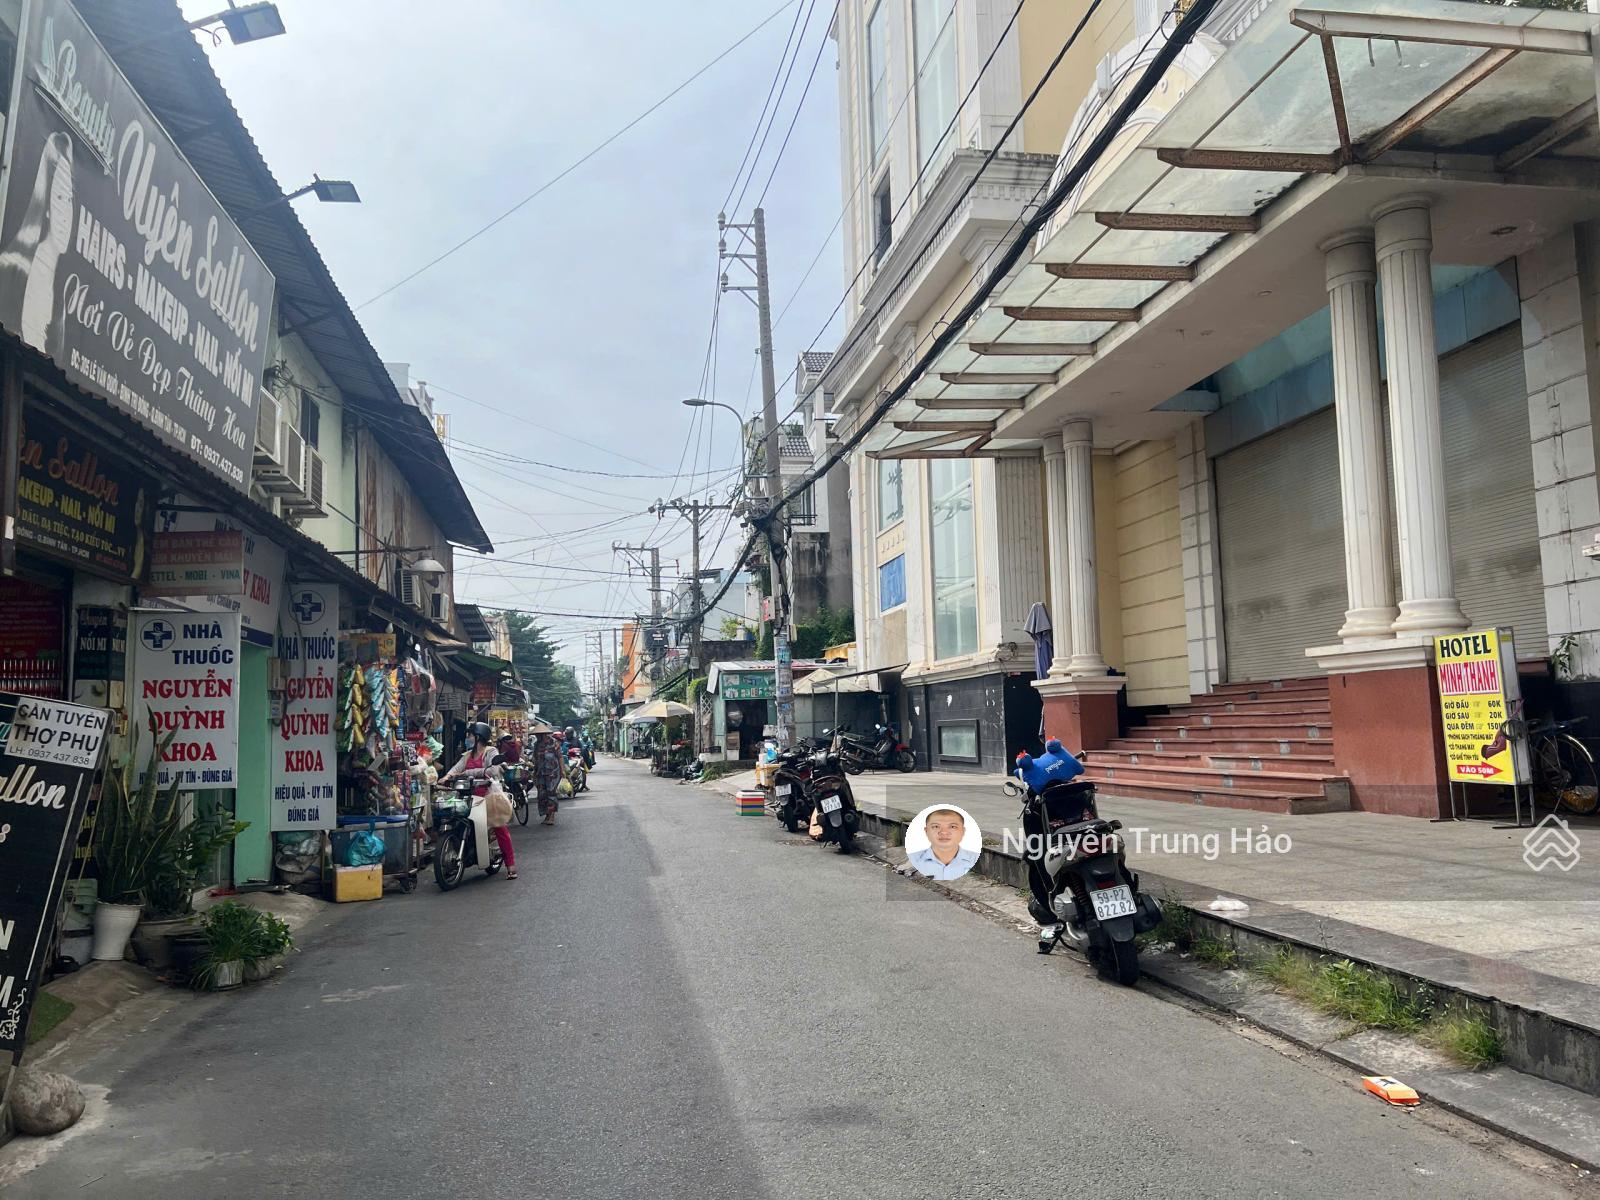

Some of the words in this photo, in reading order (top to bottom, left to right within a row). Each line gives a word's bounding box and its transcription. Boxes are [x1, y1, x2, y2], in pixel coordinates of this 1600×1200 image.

[195, 215, 260, 353] Sallon
[75, 205, 127, 290] HAIRS
[134, 262, 190, 345] MAKEUP
[194, 321, 219, 378] NAIL
[223, 347, 242, 397] NỐI
[241, 368, 254, 409] MI
[63, 273, 105, 340] Nơi
[106, 310, 135, 361] Vẻ
[138, 337, 171, 395] Đẹp
[175, 366, 217, 431] Thăng
[221, 405, 246, 451] Hoa
[190, 434, 203, 456] ĐT:
[48, 437, 118, 506] Sallon
[60, 494, 82, 521] NAIL
[220, 569, 240, 580] VINA
[250, 573, 271, 605] KHOA
[183, 620, 223, 640] NHÀ
[171, 643, 234, 665] THUỐC
[277, 633, 299, 660] NHÀ
[302, 628, 335, 660] THUỐC
[1438, 634, 1492, 658] HOTEL
[142, 669, 233, 699] NGUYỄN
[285, 666, 334, 700] GUYỄN
[1438, 662, 1464, 694] MINH
[18, 702, 51, 721] CẦN
[56, 709, 106, 730] TUYỂN
[1457, 711, 1470, 719] SAU
[1489, 711, 1503, 719] 20K
[1488, 700, 1501, 708] 60K
[148, 705, 225, 735] QUỲNH
[280, 707, 329, 741] QUỲNH
[14, 723, 57, 749] THỢ
[58, 731, 99, 756] PHỤ
[28, 748, 51, 759] 0937
[53, 753, 71, 763] 437
[72, 757, 90, 766] 838
[284, 750, 324, 773] KHOA
[186, 768, 197, 784] TÍN
[202, 767, 219, 783] ĐÚNG
[221, 767, 233, 782] GIÁ
[275, 785, 291, 804] HIỆU
[291, 781, 306, 802] QUẢ
[311, 786, 321, 799] UY
[322, 783, 333, 799] TÍN
[287, 805, 307, 822] ĐÚNG
[307, 805, 320, 821] GIÁ
[1097, 888, 1126, 905] 59-P2
[1097, 899, 1134, 918] 822.82
